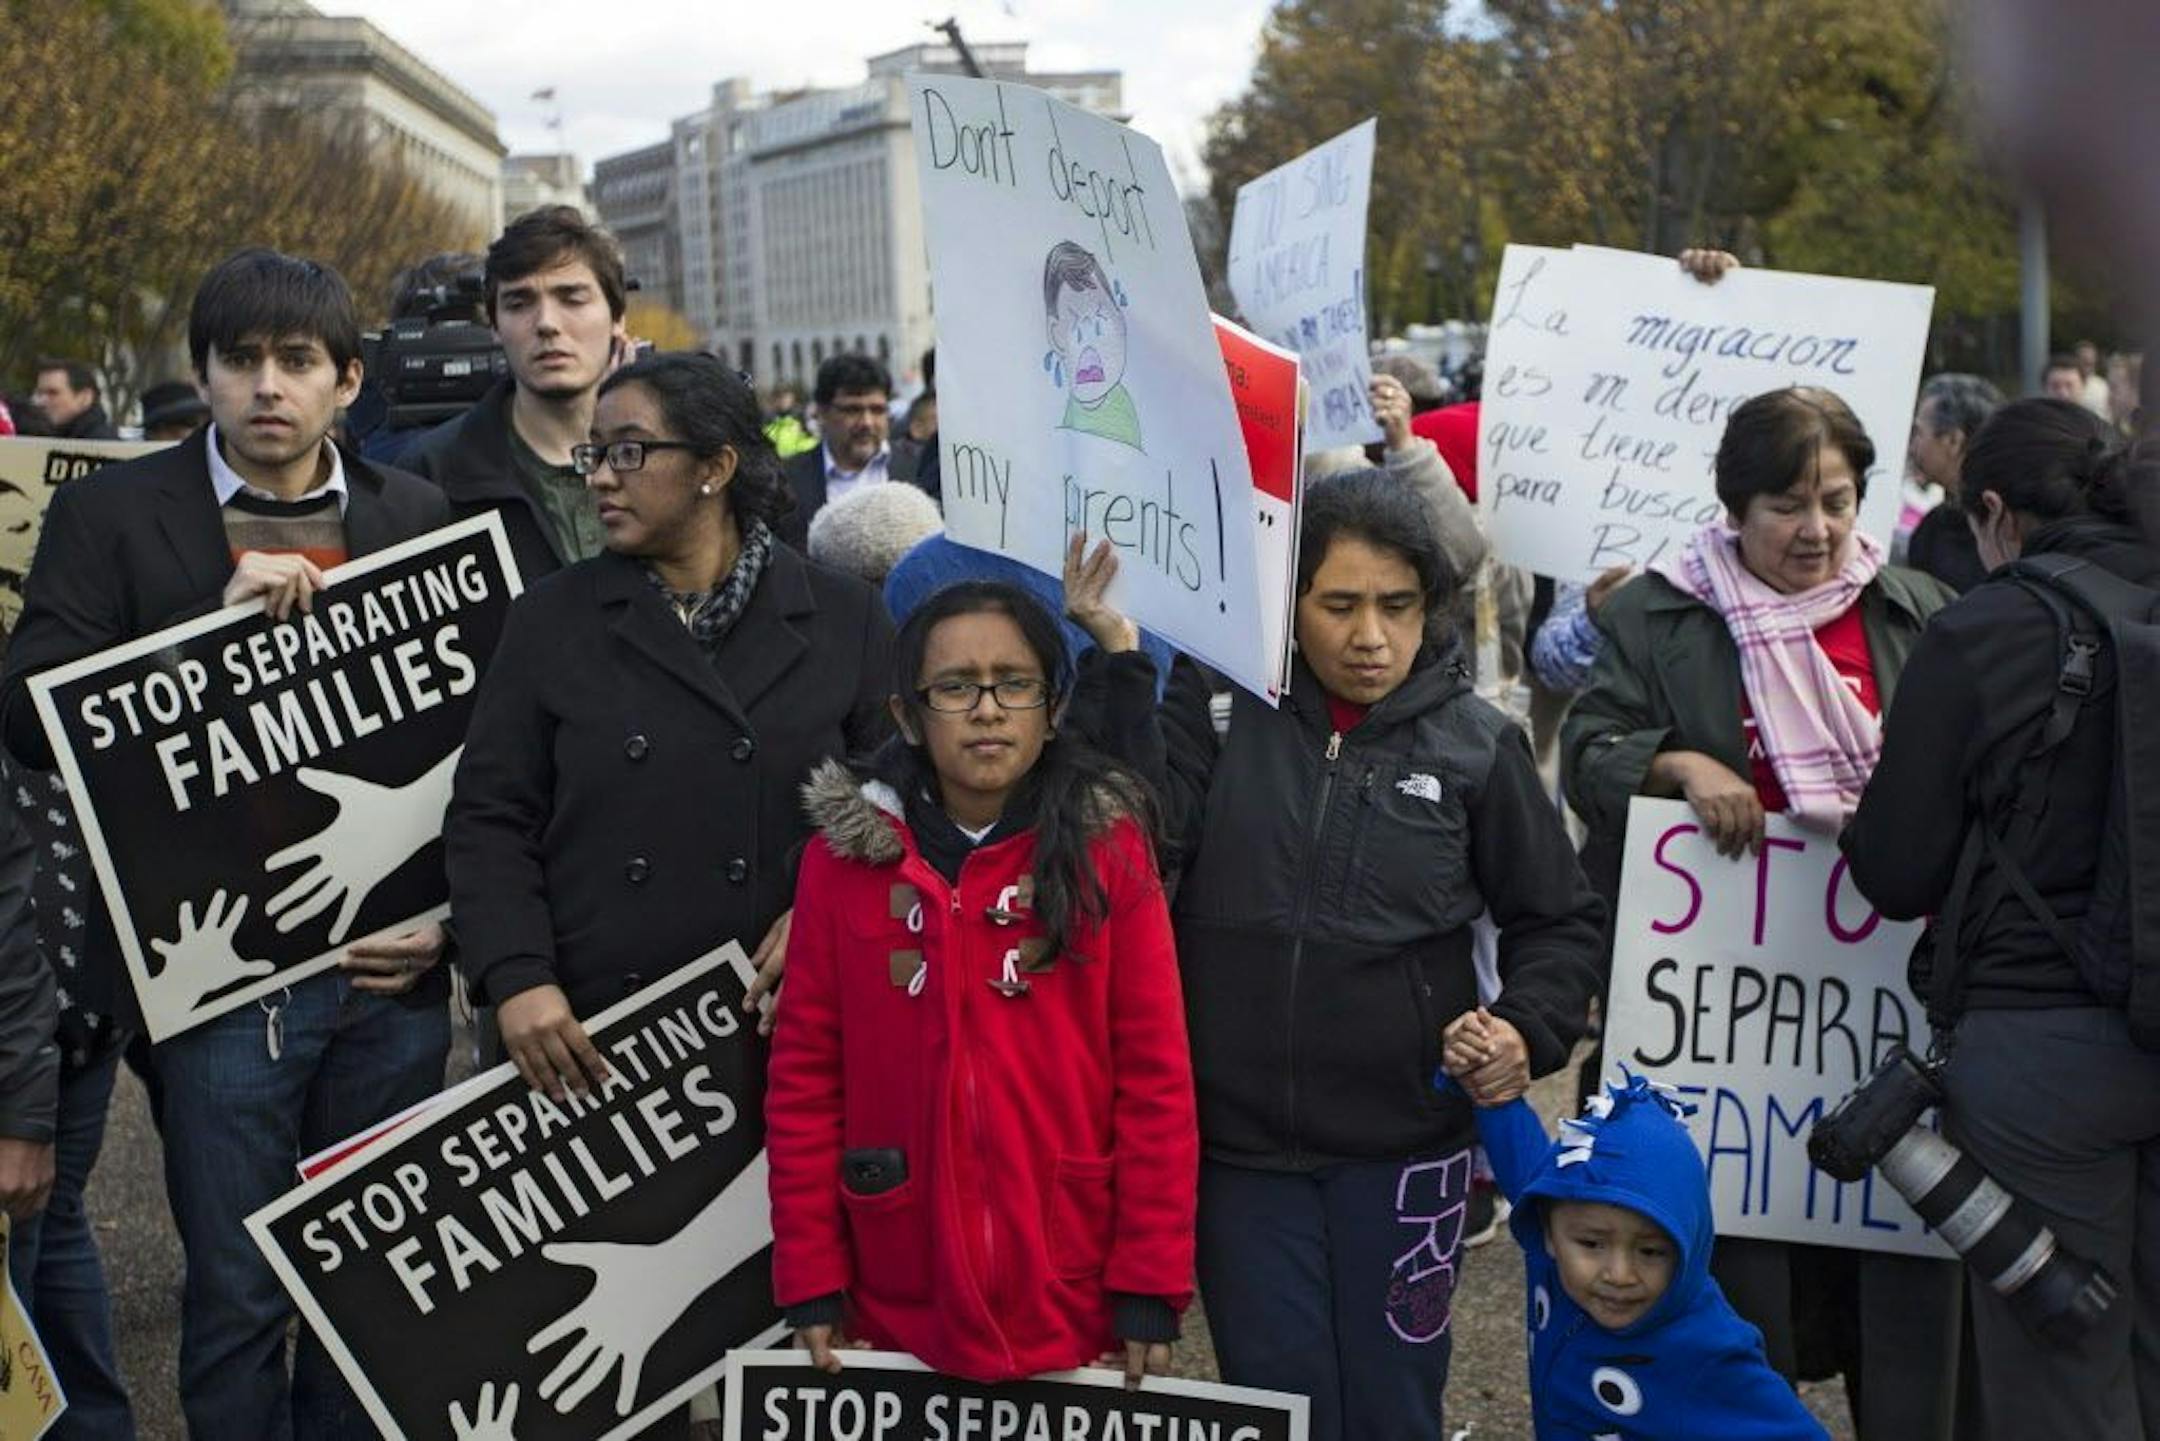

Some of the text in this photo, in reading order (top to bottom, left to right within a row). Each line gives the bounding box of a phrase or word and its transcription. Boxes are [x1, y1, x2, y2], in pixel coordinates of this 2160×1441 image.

[1045, 99, 1155, 265] deport
[1497, 256, 1858, 379] La migracion
[1497, 366, 1552, 398] es
[953, 443, 1010, 549] my
[1488, 421, 1549, 467] que
[1575, 416, 1678, 472] tiene
[1493, 473, 1562, 511] para
[81, 553, 490, 751] STOP SEPARATING
[155, 623, 477, 813] FAMILIES
[1651, 823, 1882, 945] STO
[1632, 958, 1909, 1084] SEPARA
[302, 1162, 430, 1273] STOP
[386, 1064, 738, 1316] FAMILIES
[762, 1387, 903, 1441] STOP
